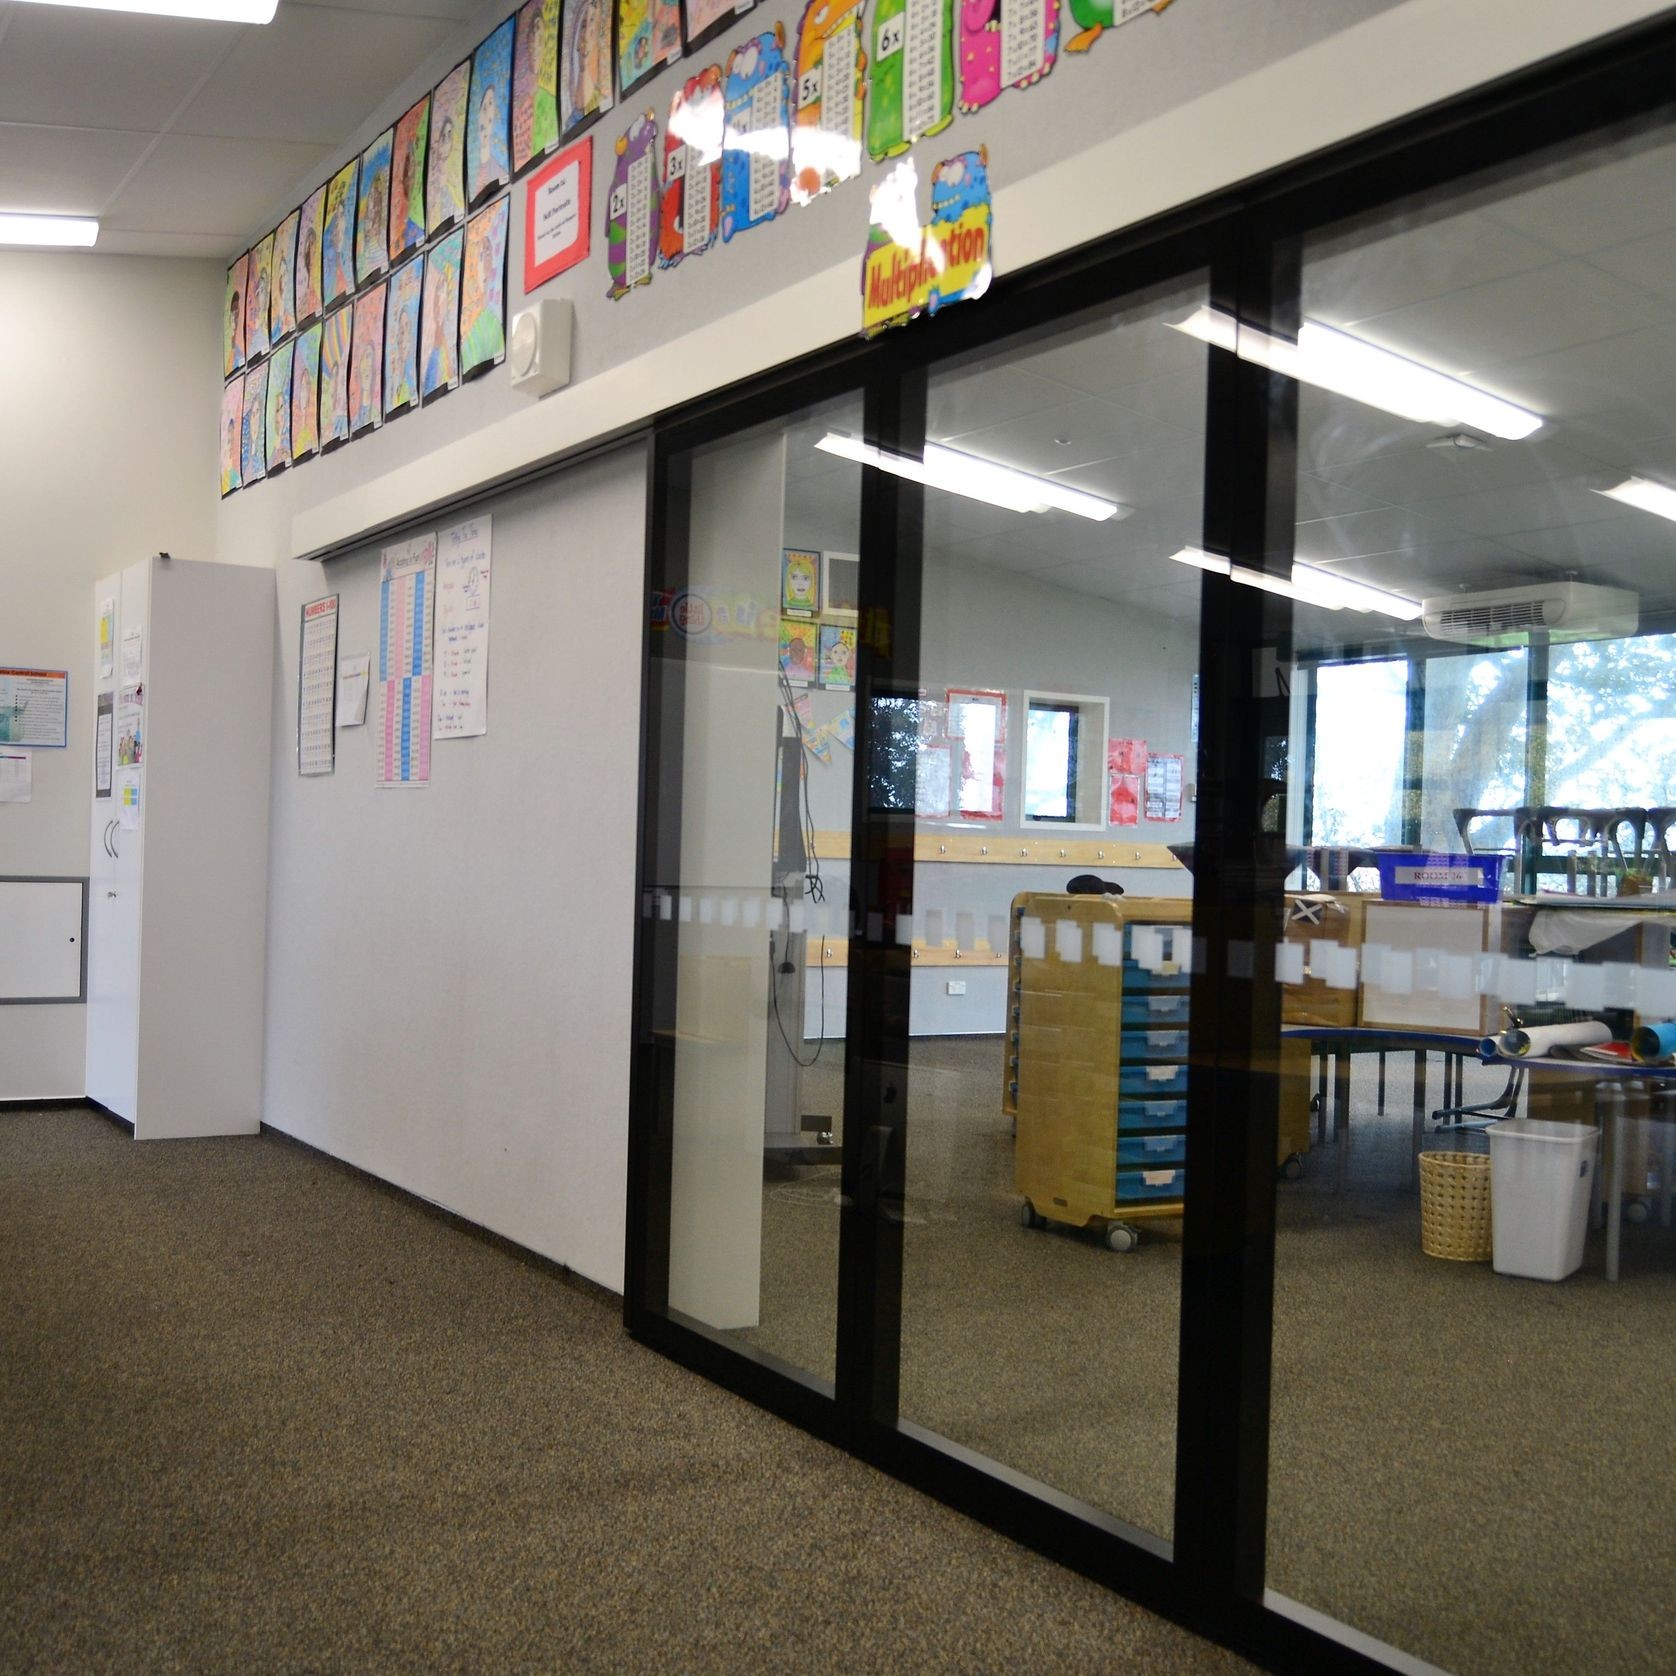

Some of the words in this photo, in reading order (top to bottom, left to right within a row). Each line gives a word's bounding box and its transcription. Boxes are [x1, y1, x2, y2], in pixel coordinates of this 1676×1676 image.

[881, 27, 900, 51] 6x
[802, 79, 818, 101] 5x
[669, 156, 683, 176] 3x
[612, 195, 625, 214] 2x
[1414, 871, 1448, 880] ROOM
